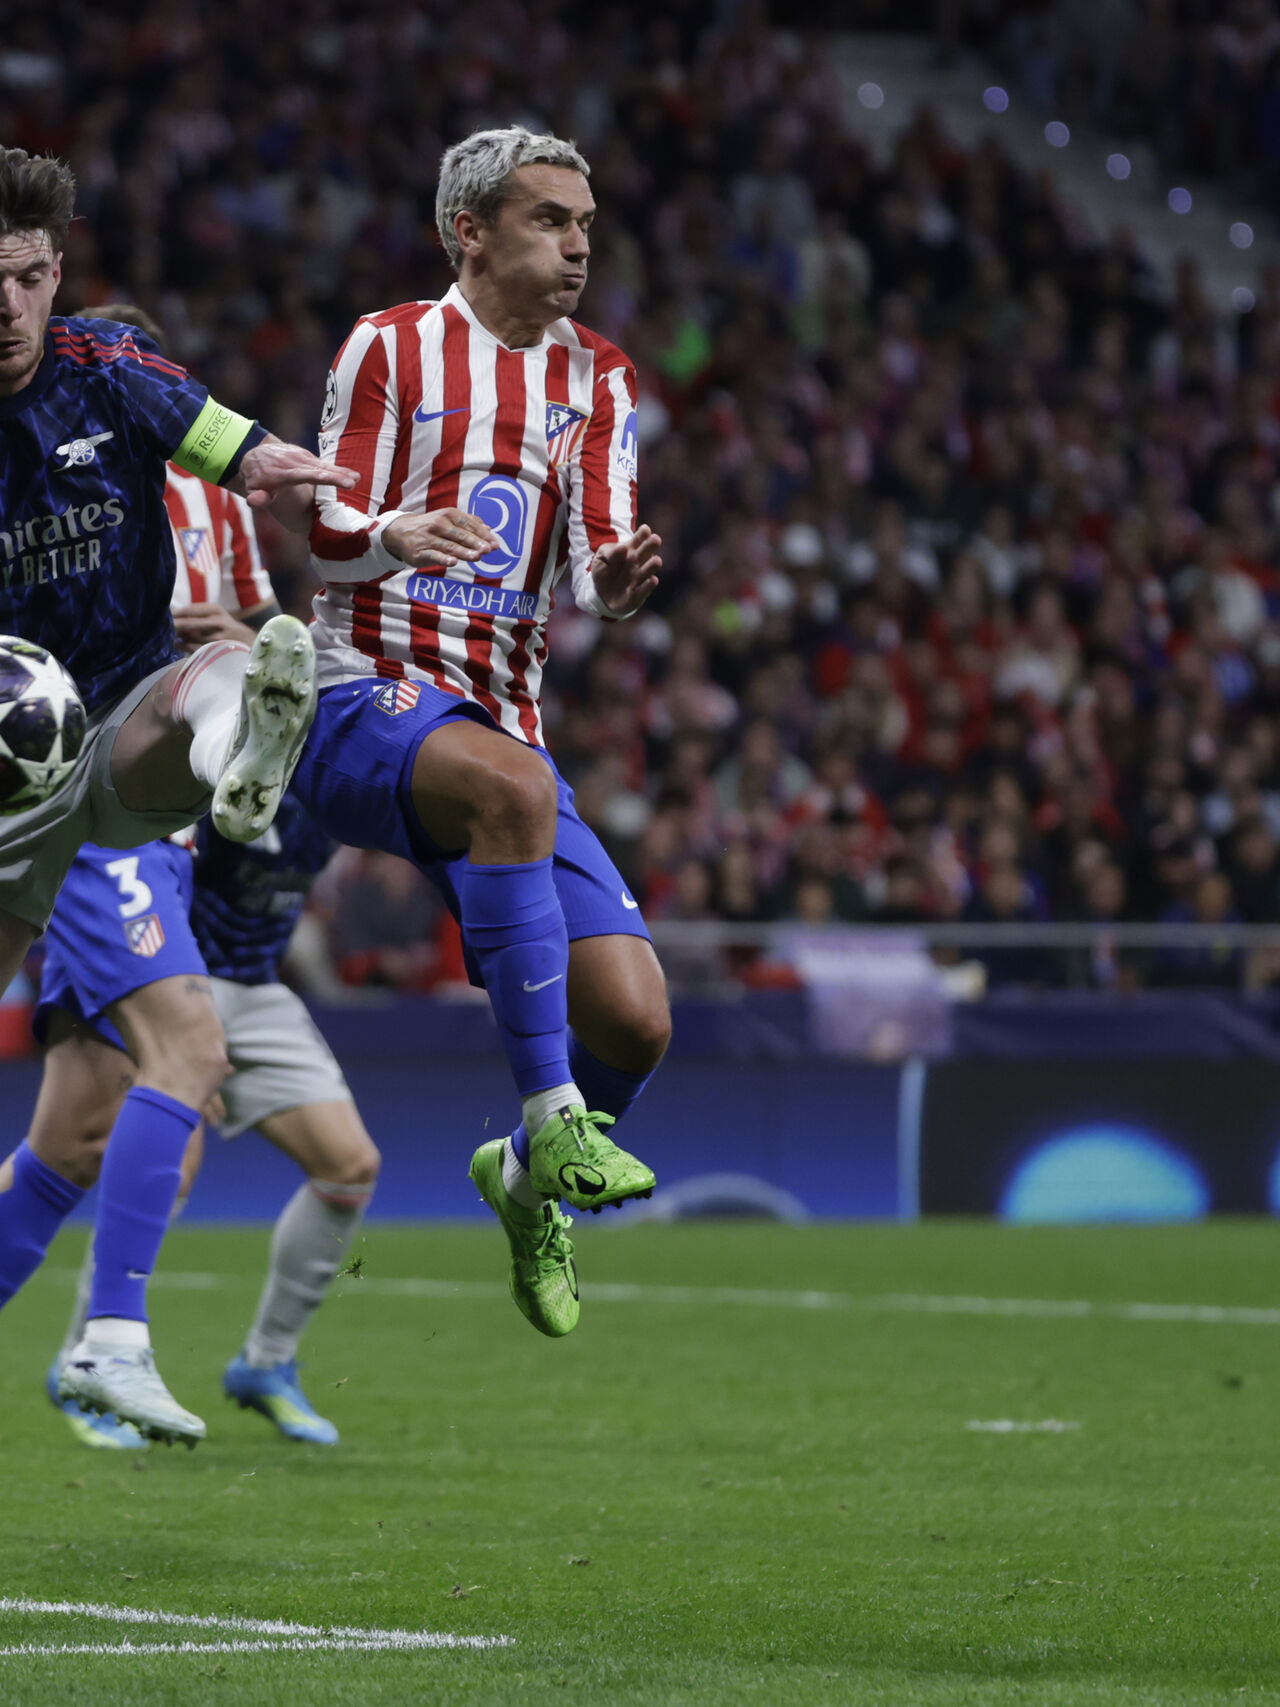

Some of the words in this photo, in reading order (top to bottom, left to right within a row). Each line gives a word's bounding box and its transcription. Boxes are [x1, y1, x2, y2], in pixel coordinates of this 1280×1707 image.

[199, 408, 229, 450] RESPEC
[616, 453, 638, 477] kra
[23, 538, 102, 587] BETTER
[412, 576, 506, 612] RIYADH
[509, 594, 536, 617] AIR
[104, 855, 153, 918] 3
